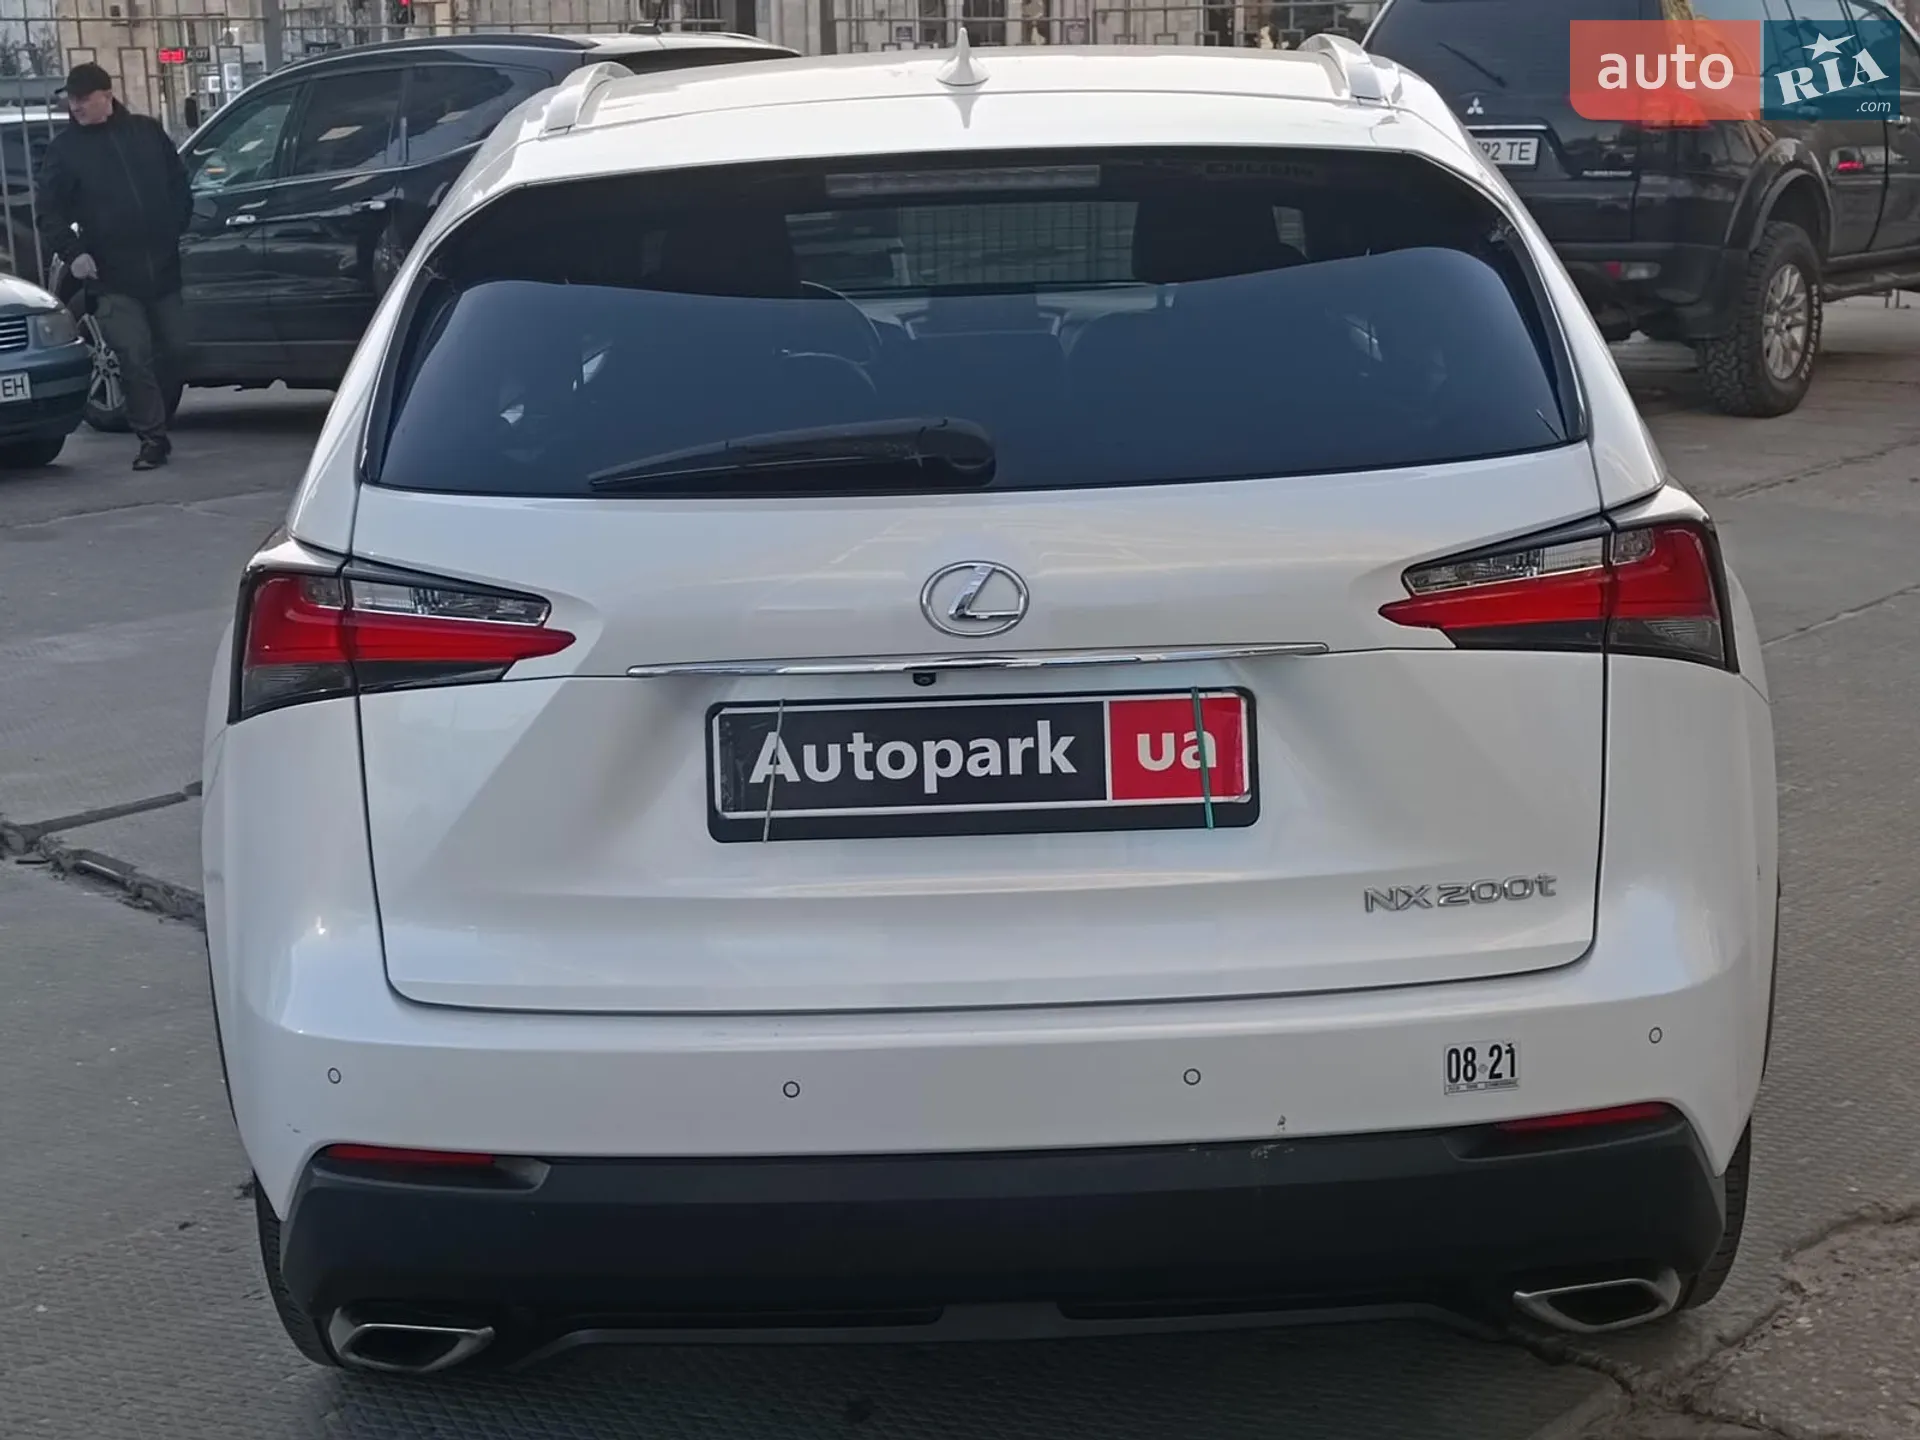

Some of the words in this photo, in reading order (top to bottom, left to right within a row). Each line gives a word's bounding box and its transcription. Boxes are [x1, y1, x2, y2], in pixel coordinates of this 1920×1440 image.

[1477, 141, 1501, 161] 92
[1506, 141, 1532, 161] TE
[2, 377, 25, 398] EH
[748, 719, 1078, 795] Autopark
[1135, 730, 1218, 772] ua
[1446, 1046, 1477, 1084] 08
